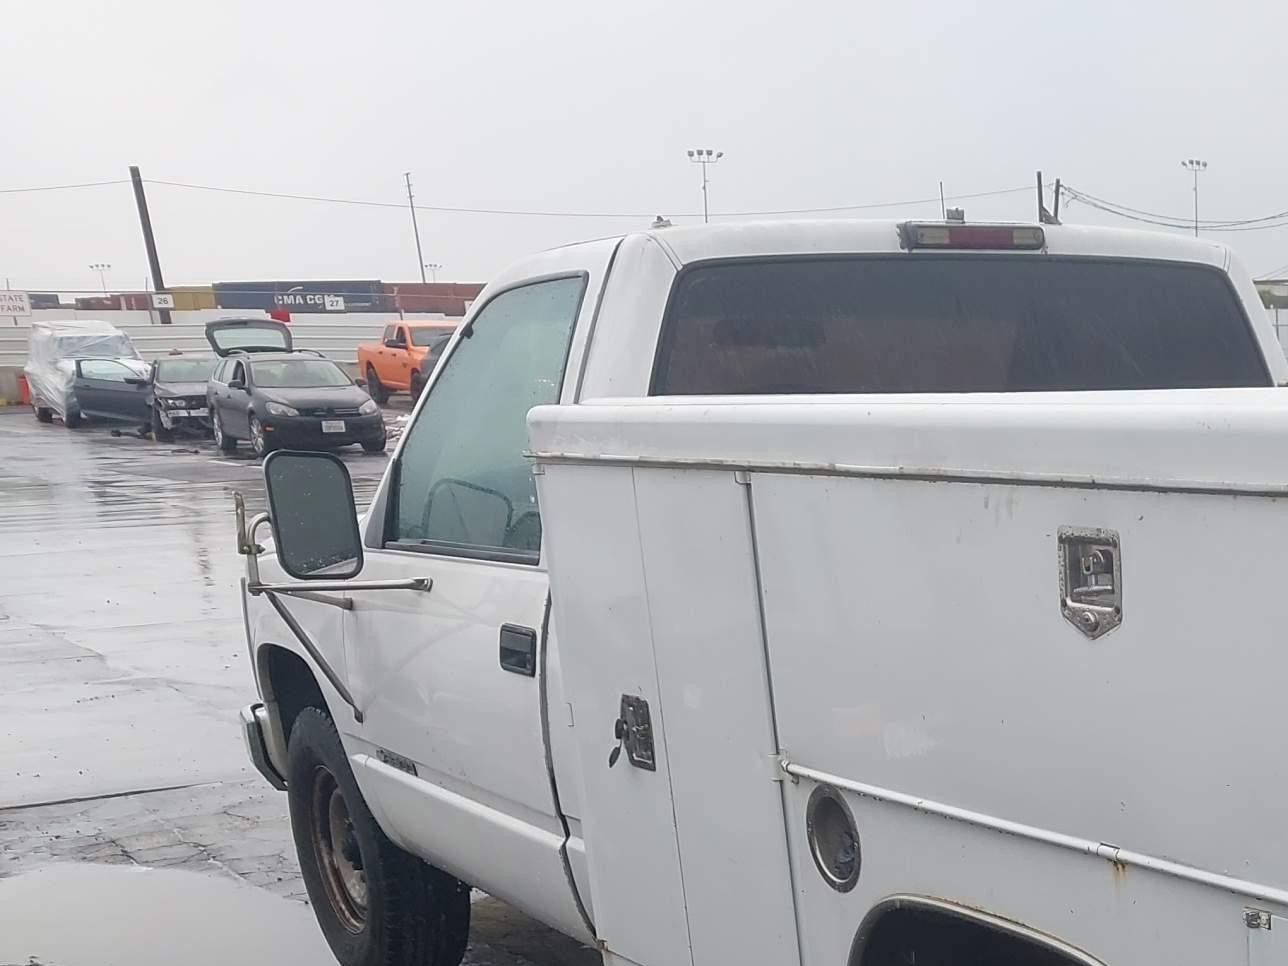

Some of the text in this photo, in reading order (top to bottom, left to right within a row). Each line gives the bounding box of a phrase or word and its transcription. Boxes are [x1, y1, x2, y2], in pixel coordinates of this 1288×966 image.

[157, 296, 168, 305] 26
[274, 295, 327, 305] CMA CG
[1, 304, 25, 312] FARM
